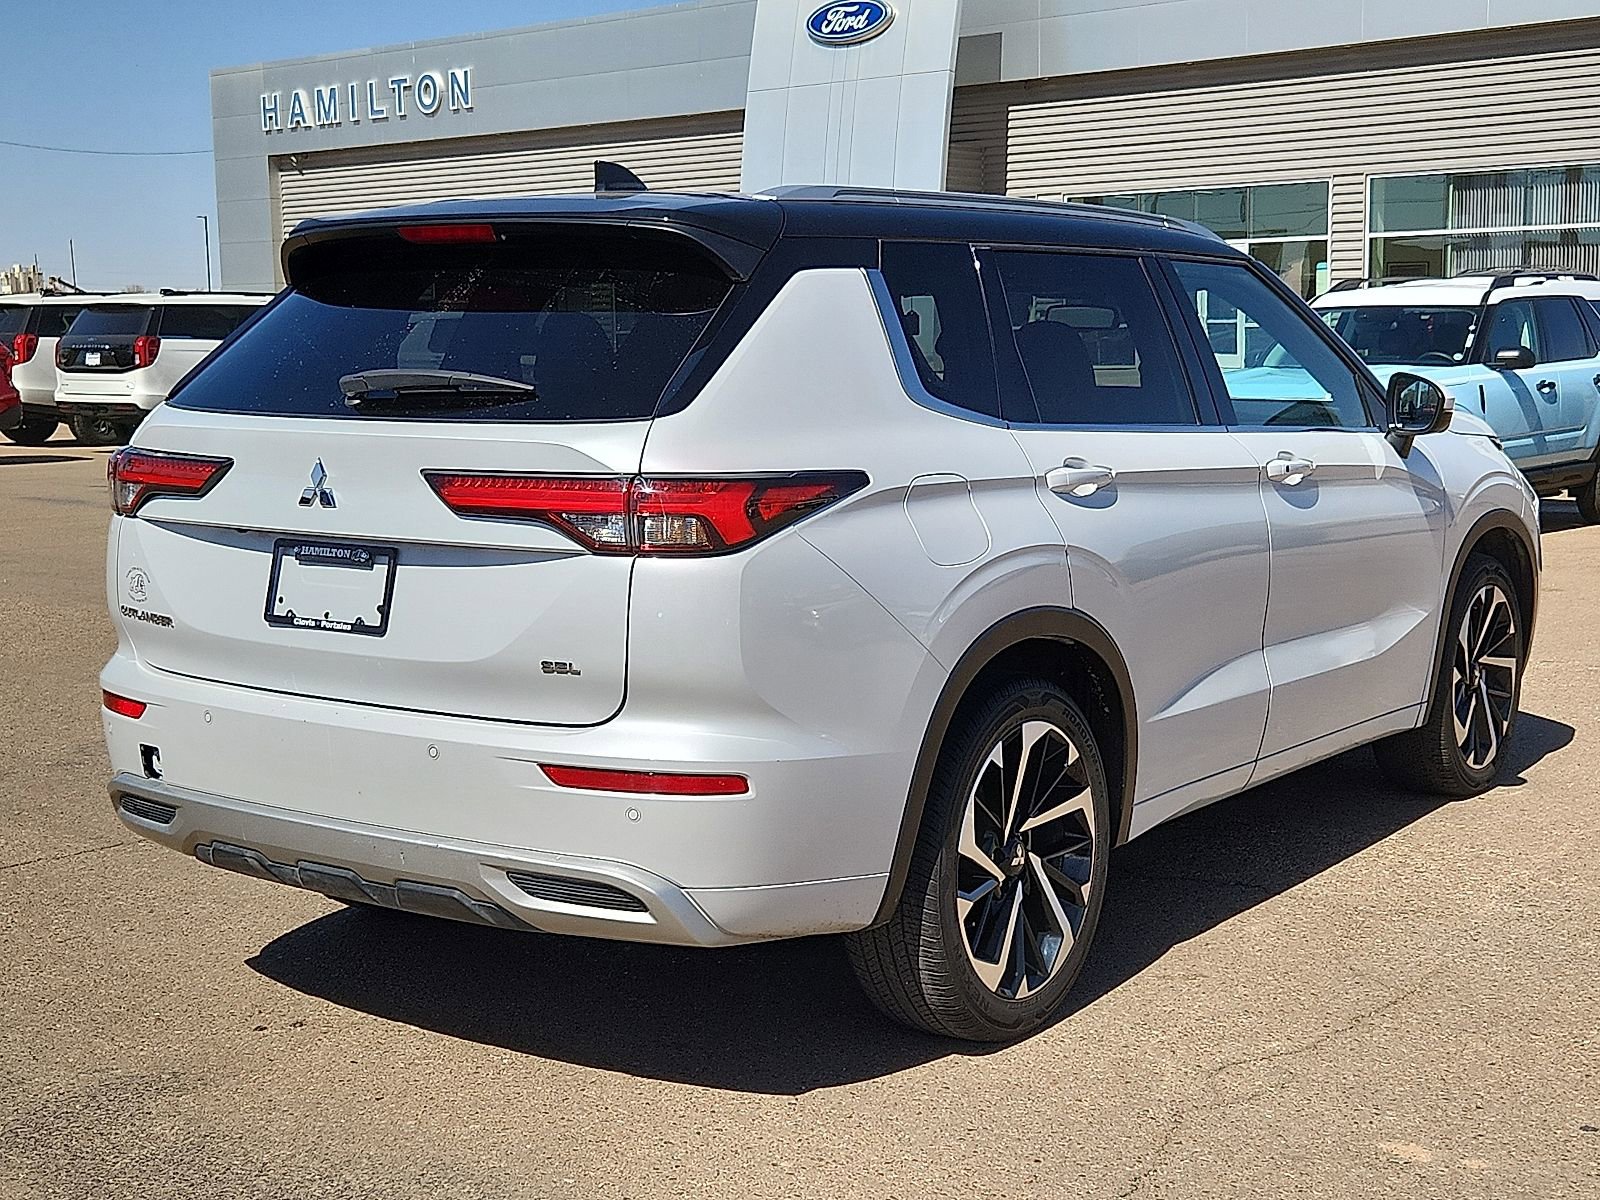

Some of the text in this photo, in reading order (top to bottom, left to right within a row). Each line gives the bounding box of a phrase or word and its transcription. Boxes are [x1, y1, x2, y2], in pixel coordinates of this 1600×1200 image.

[821, 5, 872, 34] Ford
[260, 66, 474, 132] HAMILTON
[300, 545, 352, 559] HAMILTON
[120, 604, 175, 629] OUTLANDER
[293, 617, 316, 627] Clovis
[540, 660, 582, 676] SEL
